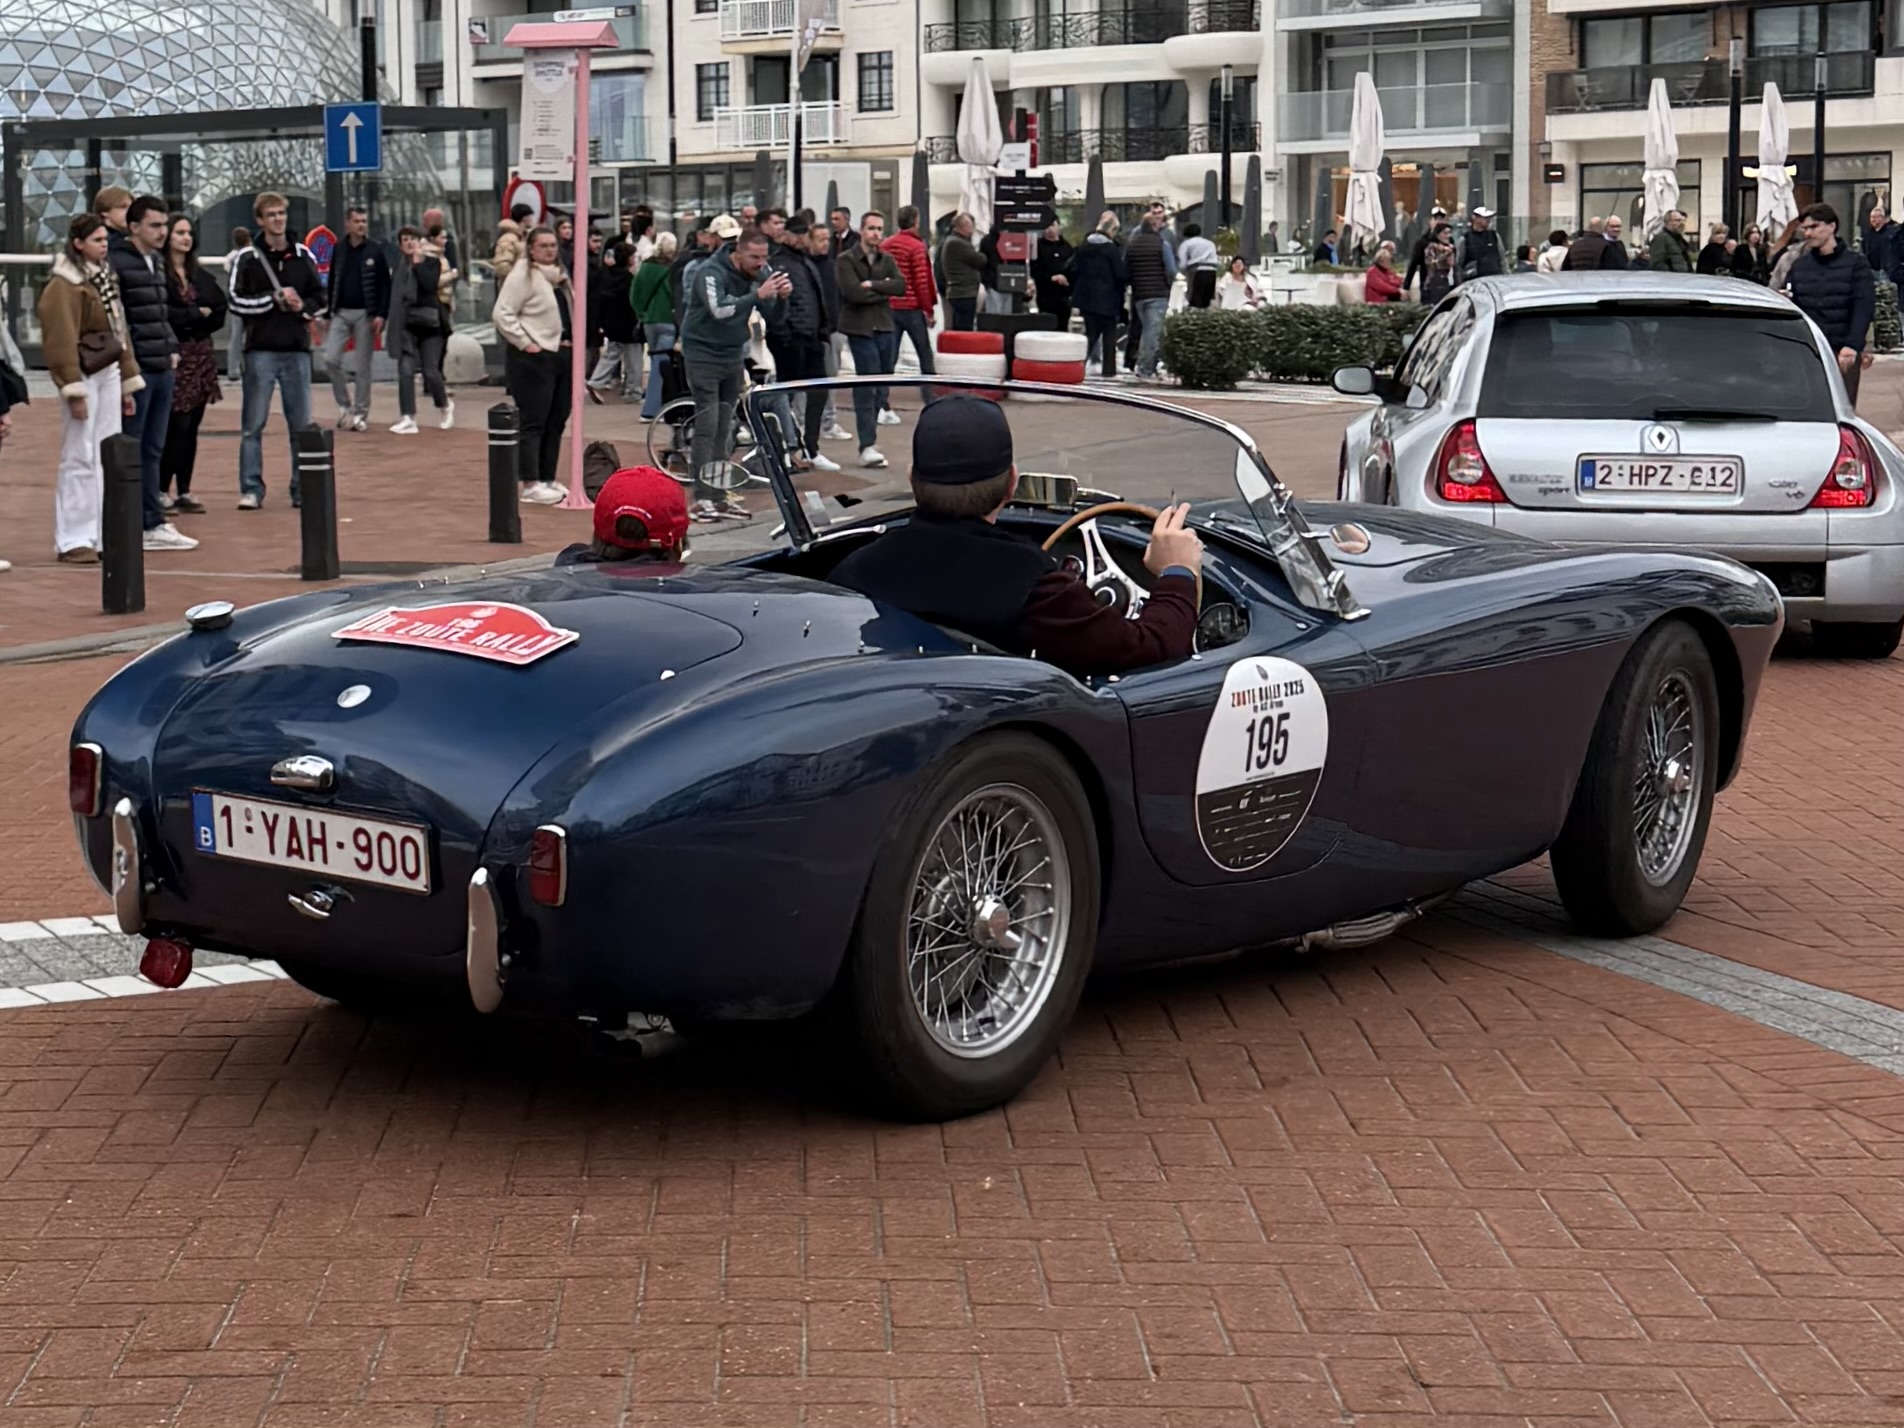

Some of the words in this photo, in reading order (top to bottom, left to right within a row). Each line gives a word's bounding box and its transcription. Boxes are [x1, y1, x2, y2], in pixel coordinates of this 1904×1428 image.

[395, 621, 474, 642] ZOUTE
[469, 631, 566, 654] RALLY
[1231, 688, 1256, 708] ZOUTE
[1259, 683, 1282, 702] RALLY
[1245, 712, 1290, 772] 195
[200, 827, 213, 847] B
[220, 805, 421, 881] 1-YAH-900
